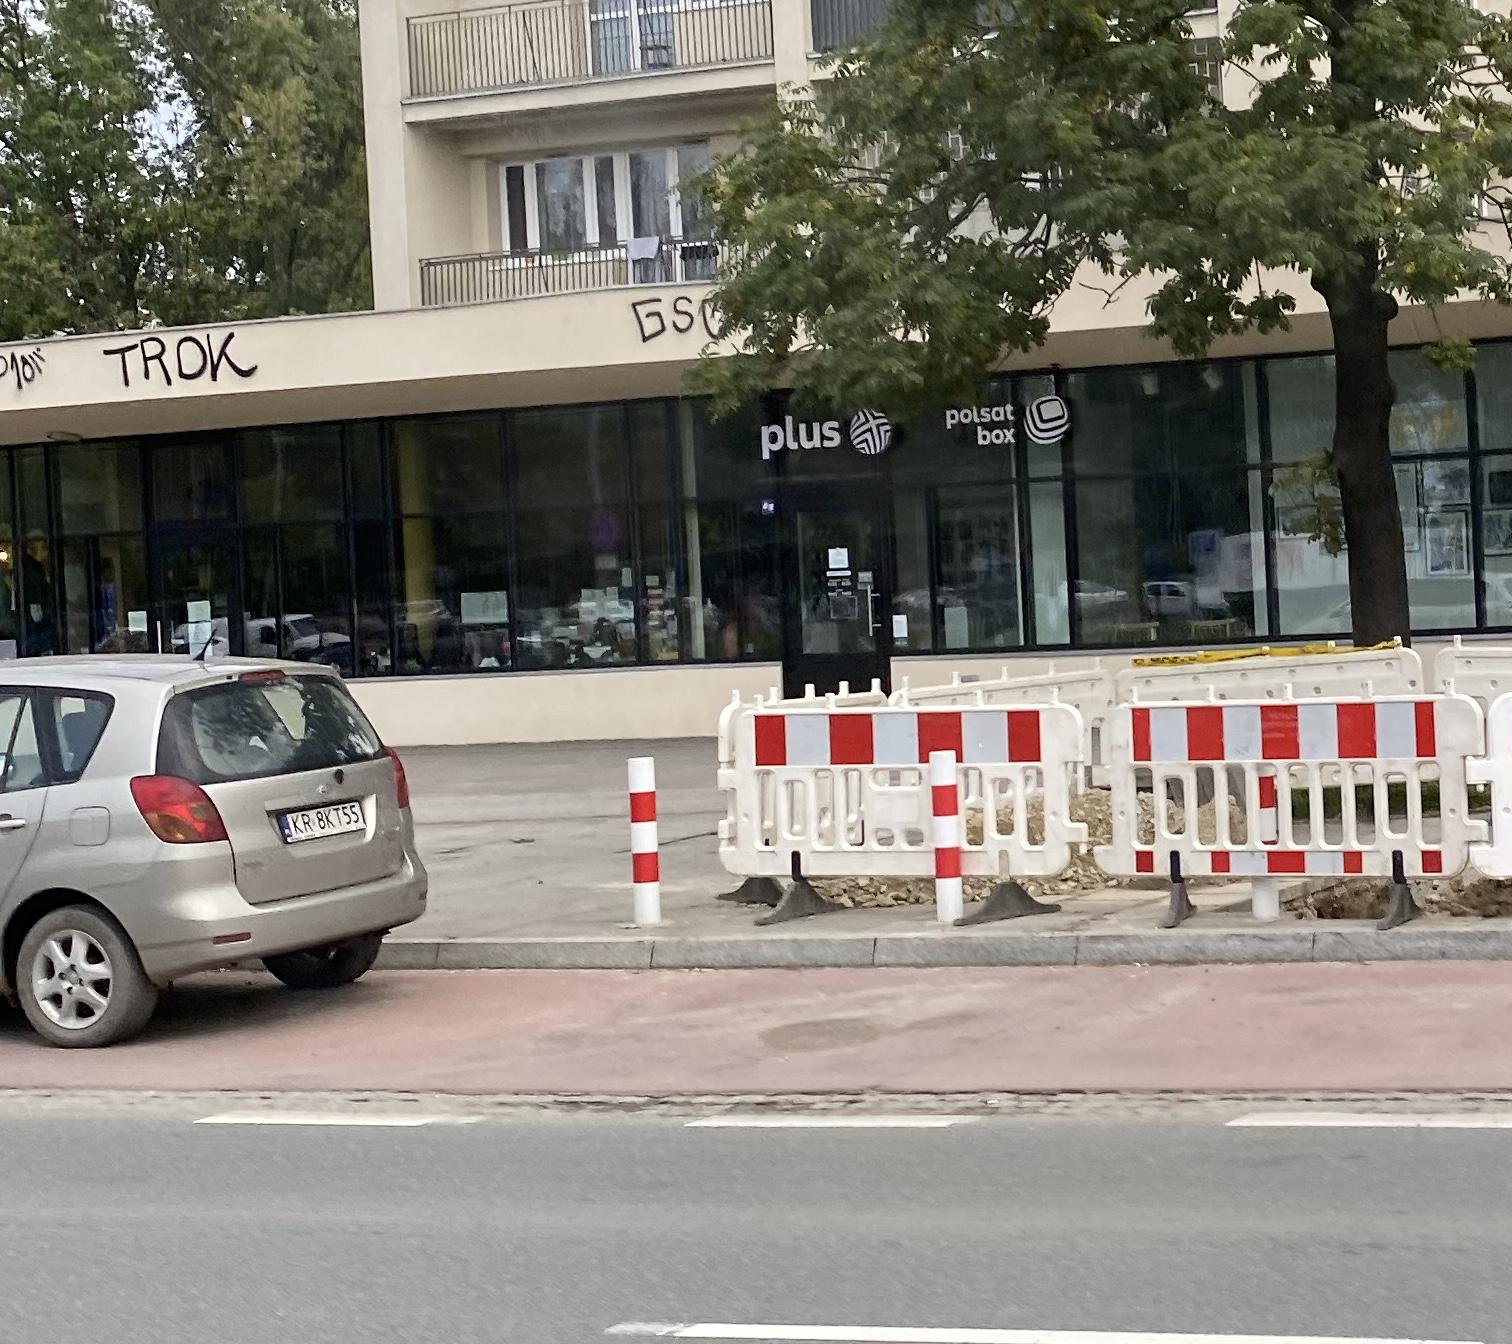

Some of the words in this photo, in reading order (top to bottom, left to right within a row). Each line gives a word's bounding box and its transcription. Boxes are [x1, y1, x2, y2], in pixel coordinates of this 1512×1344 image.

[102, 331, 258, 388] TROK
[944, 403, 1015, 430] polsat
[760, 415, 840, 460] plus
[976, 425, 1015, 446] box
[291, 813, 314, 835] KR
[316, 805, 360, 830] 8KT55
